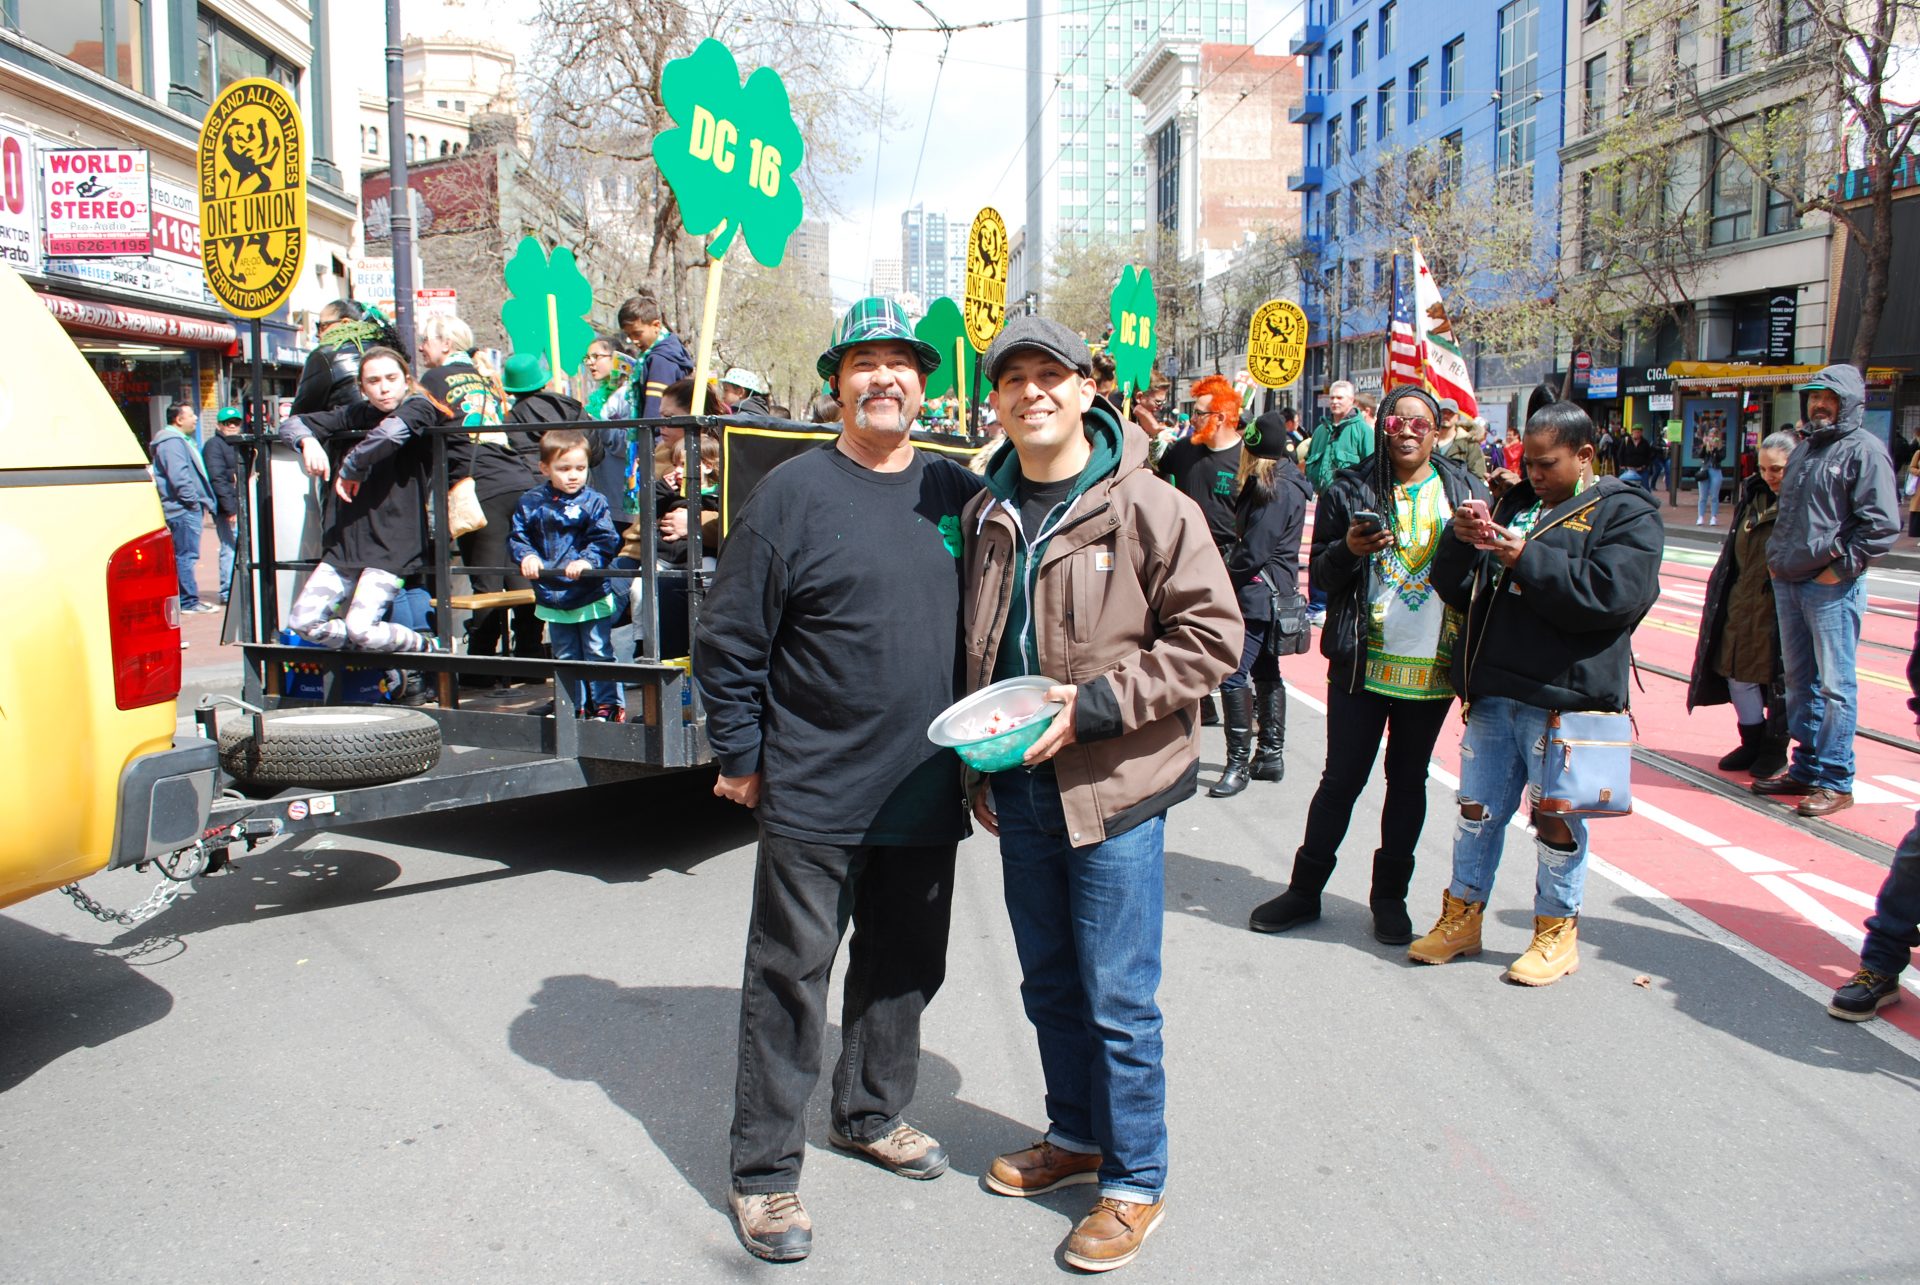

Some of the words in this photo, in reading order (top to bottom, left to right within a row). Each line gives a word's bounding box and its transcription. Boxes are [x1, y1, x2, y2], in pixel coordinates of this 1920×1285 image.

[203, 116, 222, 197] PAINTERS
[220, 90, 245, 120] AND
[246, 87, 289, 120] ALLIED
[282, 117, 299, 185] TRADES
[688, 104, 738, 174] DC
[748, 137, 782, 198] 16
[49, 154, 133, 174] WORLD
[51, 181, 75, 195] OF
[50, 200, 136, 219] STEREO
[206, 200, 238, 238] ONE
[243, 191, 296, 232] UNION
[77, 240, 147, 251] 626-1195
[113, 271, 138, 286] SHURE
[206, 244, 280, 308] INTERNATIONAL
[276, 231, 300, 288] UNION
[357, 273, 384, 285] BEER
[967, 274, 982, 298] ONE
[983, 279, 1006, 305] UNION
[1120, 311, 1137, 346] DC
[1138, 316, 1151, 350] 16
[1252, 341, 1270, 355] ONE
[1272, 343, 1301, 359] UNION
